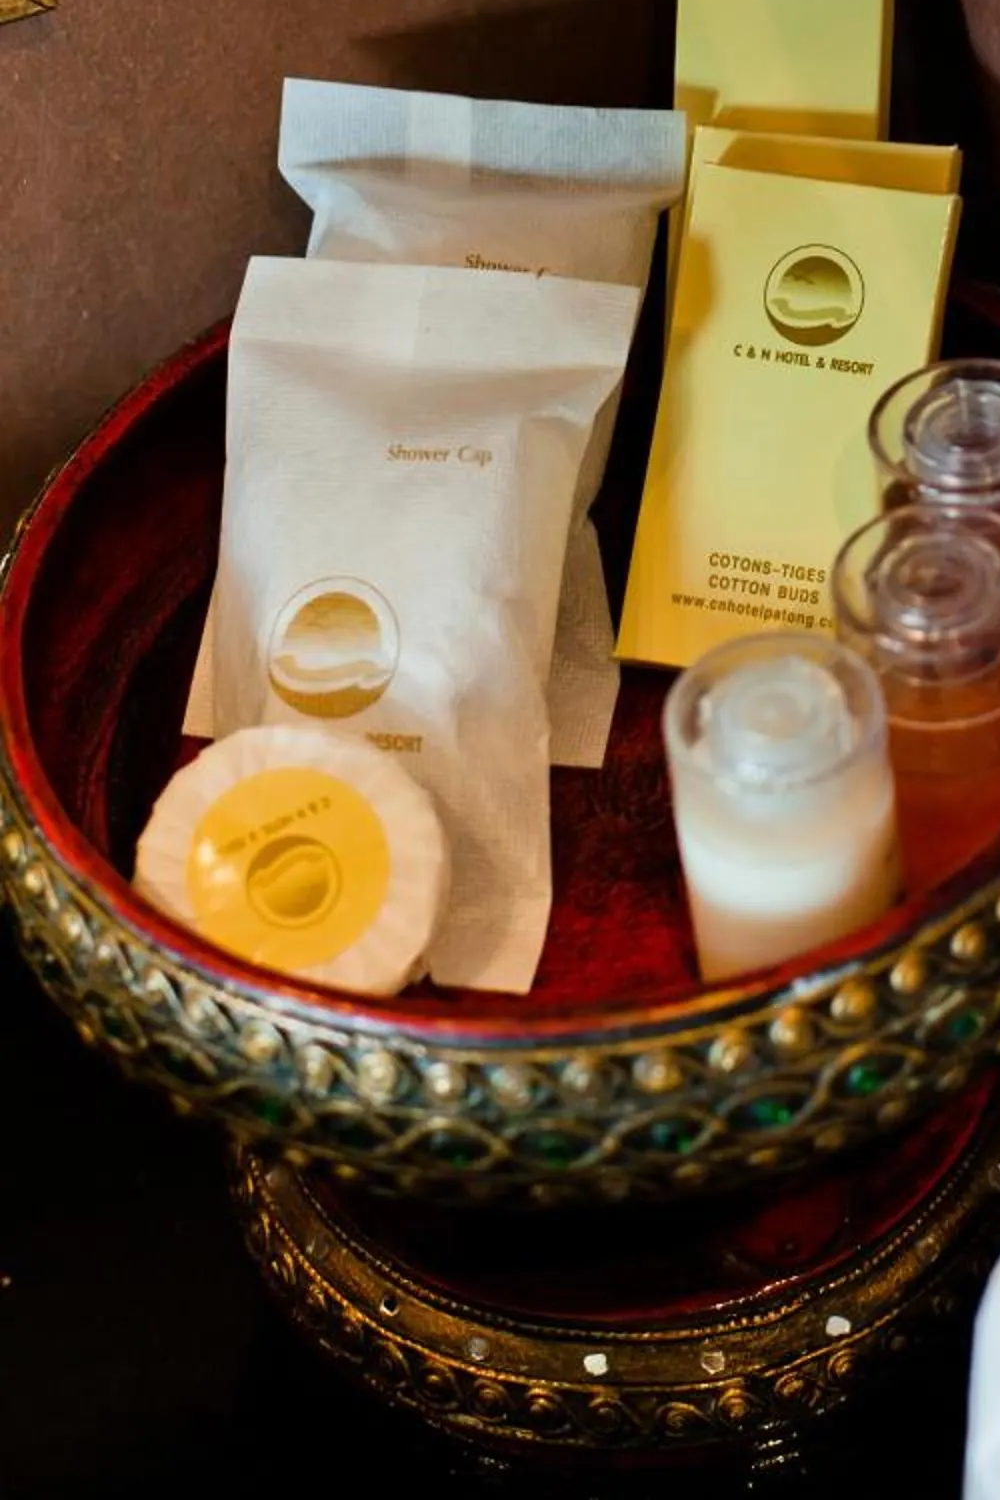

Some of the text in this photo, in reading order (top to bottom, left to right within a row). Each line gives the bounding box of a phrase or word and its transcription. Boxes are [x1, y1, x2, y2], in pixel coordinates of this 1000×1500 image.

[733, 343, 874, 376] C & N HOTEL & RESORT
[386, 443, 493, 467] Shower Cap
[708, 552, 826, 584] COTONS-TIGES
[708, 574, 820, 605] COTTON BUDS
